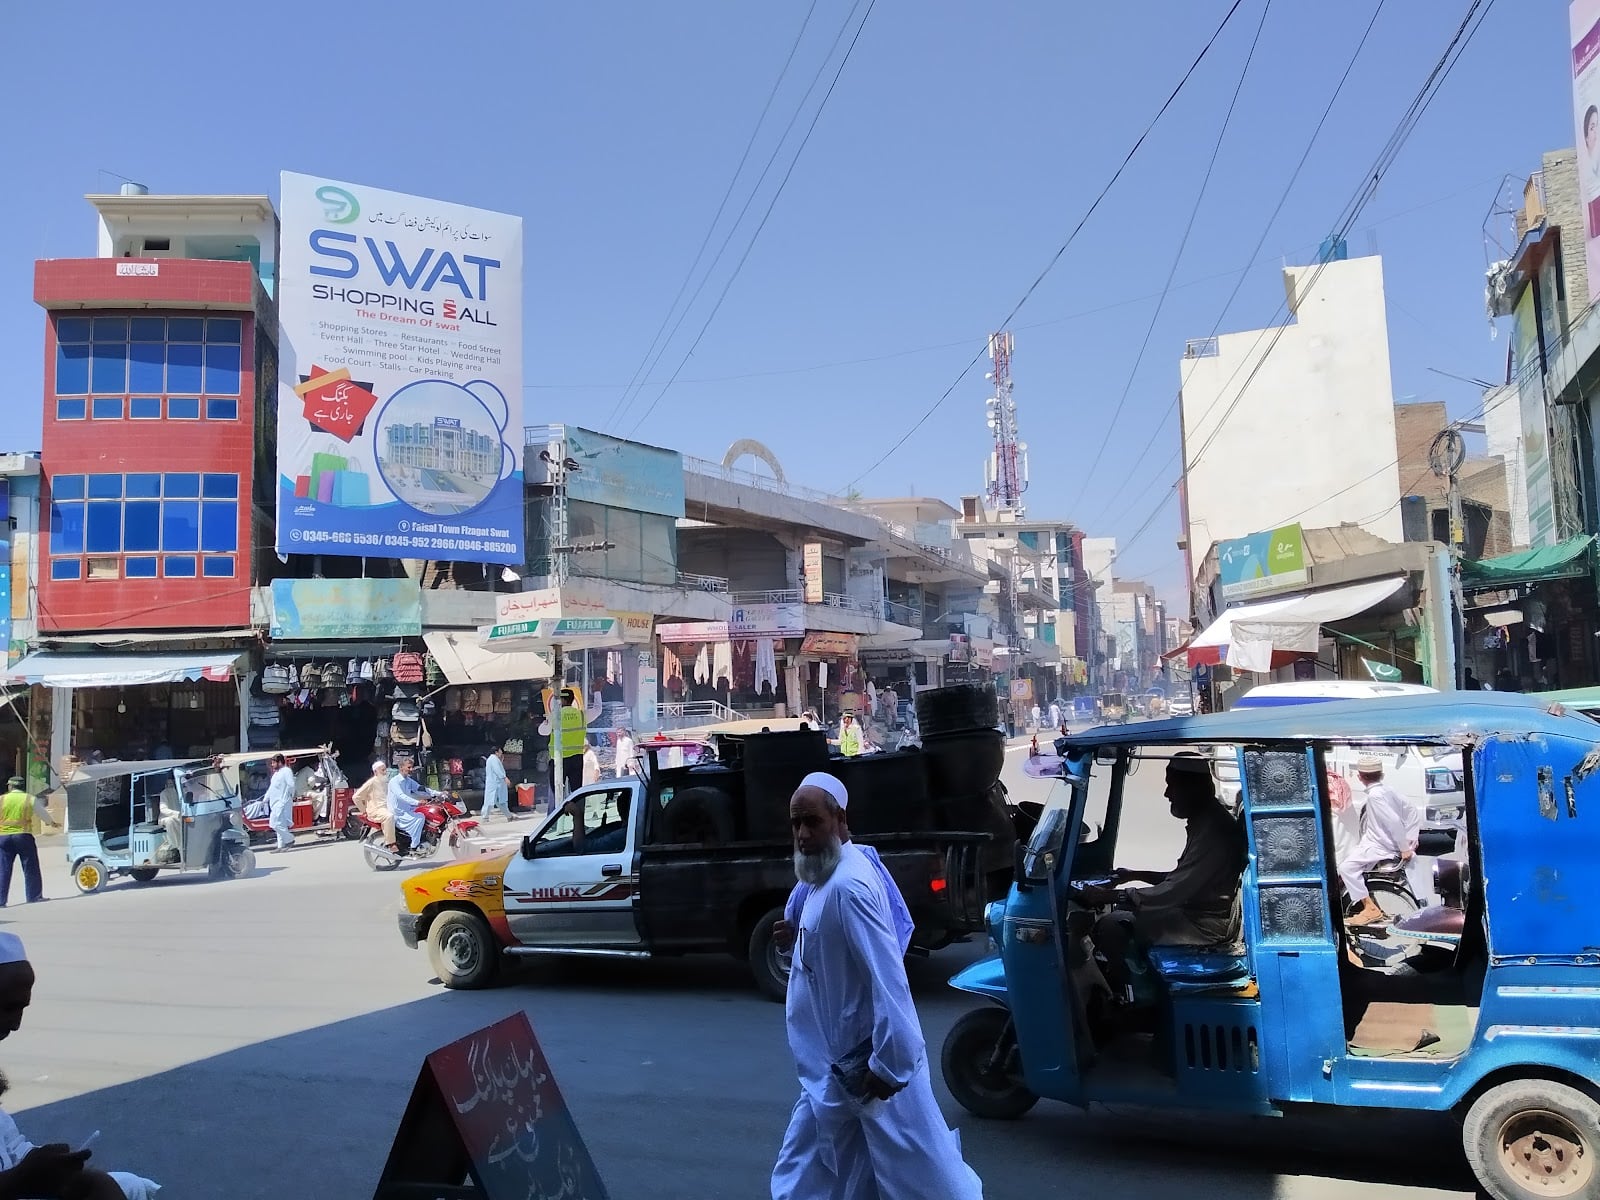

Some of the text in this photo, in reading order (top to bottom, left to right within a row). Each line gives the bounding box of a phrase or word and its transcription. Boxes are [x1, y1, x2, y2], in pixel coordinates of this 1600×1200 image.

[309, 229, 500, 301] SWAT
[312, 284, 435, 316] SHOPPING
[356, 309, 461, 331] The Dream Of swat
[319, 321, 501, 355] Shopping Stores Restaurants Food Street
[321, 332, 501, 365] Event Hall Three Star Hotel Wedding Hall
[324, 354, 454, 379] Food Court Stalls Car Parking
[343, 346, 482, 372] Swimming pool Kids Playing area
[313, 407, 354, 425] جاری ہے
[437, 417, 458, 426] SWAT
[412, 522, 510, 538] Faisal Town Fizagat Swat
[498, 623, 528, 636] FUJIFILM
[566, 619, 602, 630] FUJIFILM
[627, 617, 650, 629] HOUSE
[532, 887, 582, 898] HILUX
